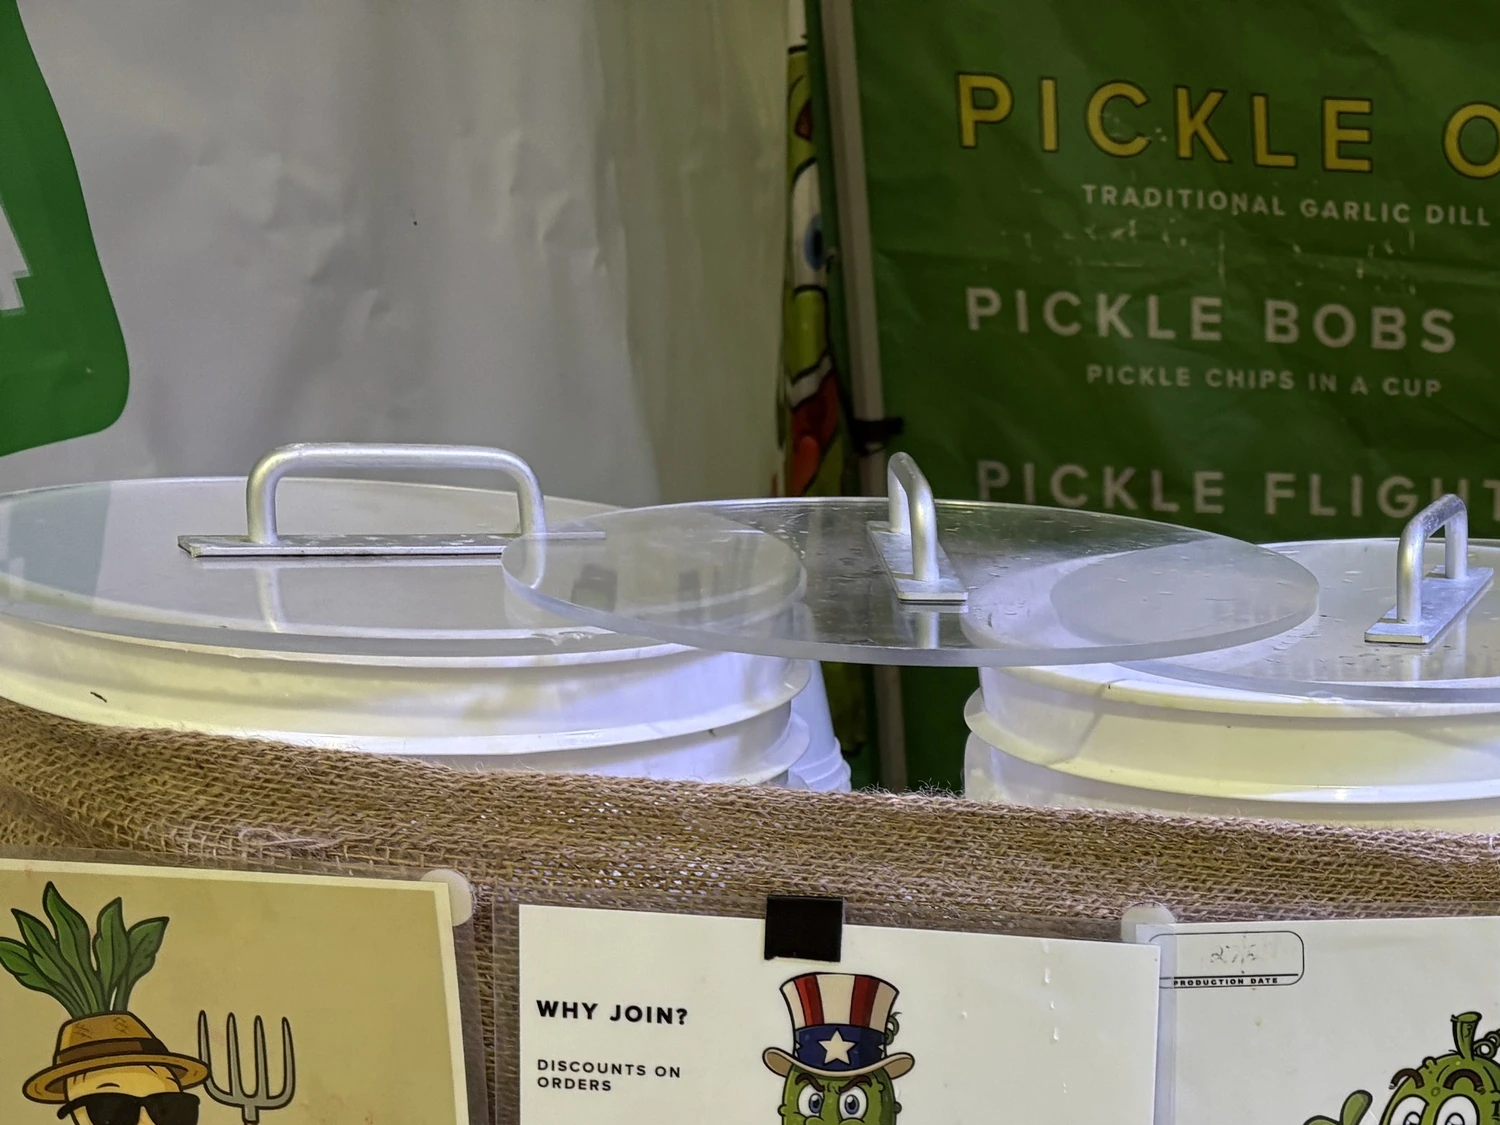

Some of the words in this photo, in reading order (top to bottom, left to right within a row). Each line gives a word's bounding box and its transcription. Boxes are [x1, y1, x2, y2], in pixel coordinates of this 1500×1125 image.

[956, 72, 1373, 173] PICKLE
[1081, 184, 1286, 216] TRADITIONAL
[1300, 199, 1411, 224] GARLIC
[1426, 204, 1490, 227] DILL
[965, 286, 1222, 341] PICKLE
[1265, 298, 1456, 354] BOBS
[1086, 363, 1191, 387] PICKLE
[1205, 367, 1294, 390] CHIPS
[1308, 373, 1337, 392] IN
[1350, 376, 1368, 395] A
[1382, 376, 1442, 398] CUP
[976, 459, 1224, 514] PICKLE
[1173, 977, 1244, 987] PRODUCTION
[1250, 976, 1279, 985] DATE
[536, 999, 599, 1021] WHY
[609, 1004, 688, 1026] JOIN?
[537, 1058, 647, 1077] DISCOUNTS
[654, 1065, 681, 1079] ON
[537, 1075, 612, 1092] ORDERS
